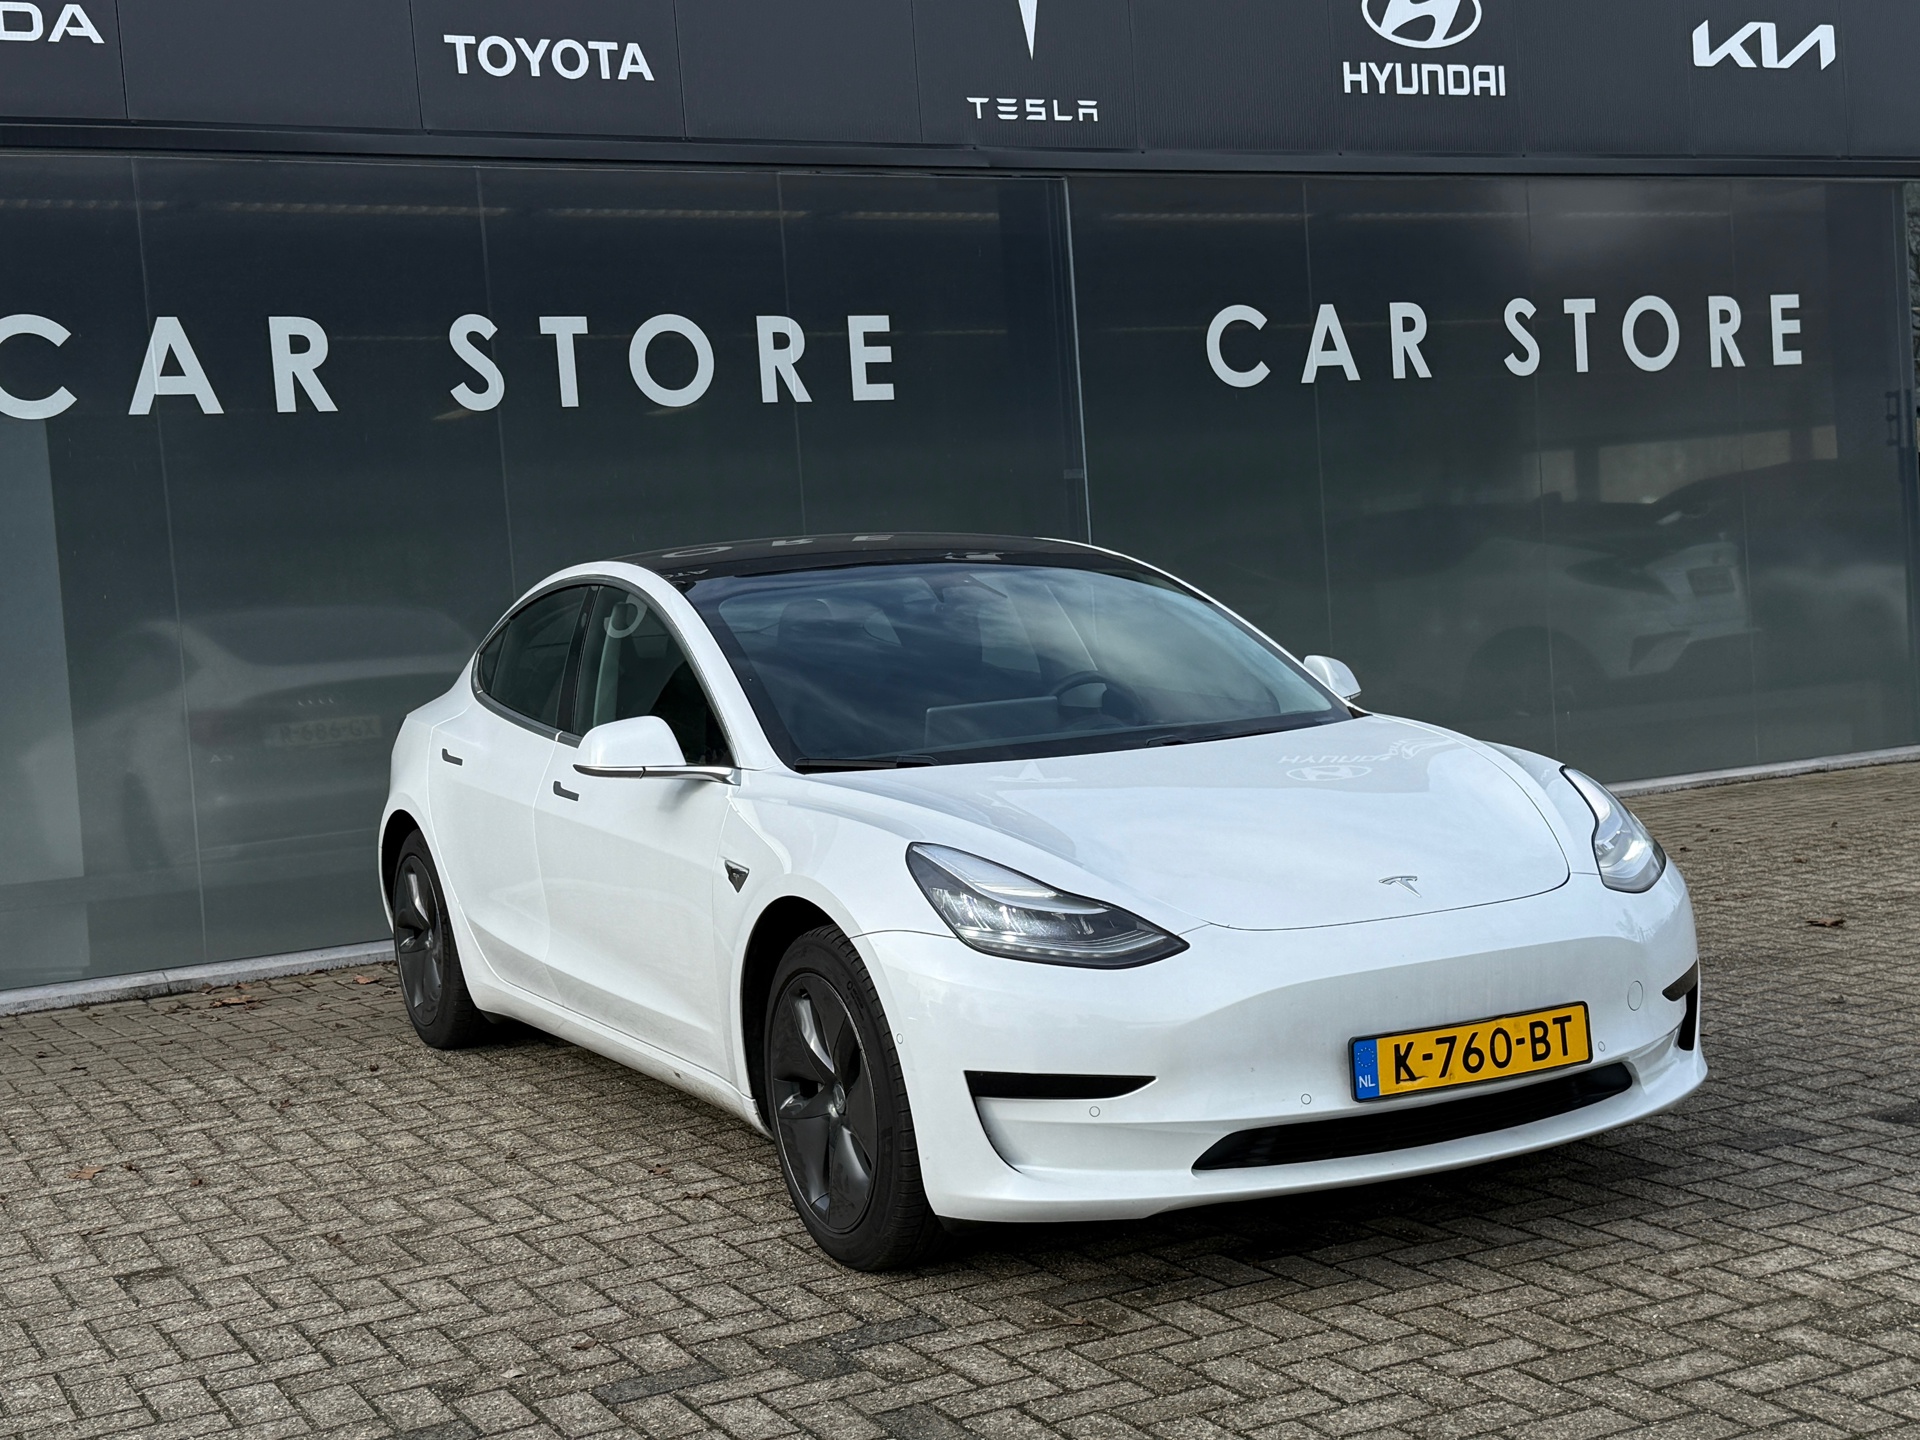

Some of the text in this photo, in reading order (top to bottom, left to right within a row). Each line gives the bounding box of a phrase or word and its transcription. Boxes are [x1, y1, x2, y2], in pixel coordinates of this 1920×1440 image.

[444, 35, 654, 81] TOYOTA
[1692, 20, 1835, 70] KIA
[1343, 62, 1505, 96] HYUNDAI
[967, 97, 1098, 121] TESLA
[1207, 294, 1802, 387] CAR STORE
[0, 314, 894, 419] CAR STORE
[1359, 1015, 1572, 1089] NL K-760-BT
